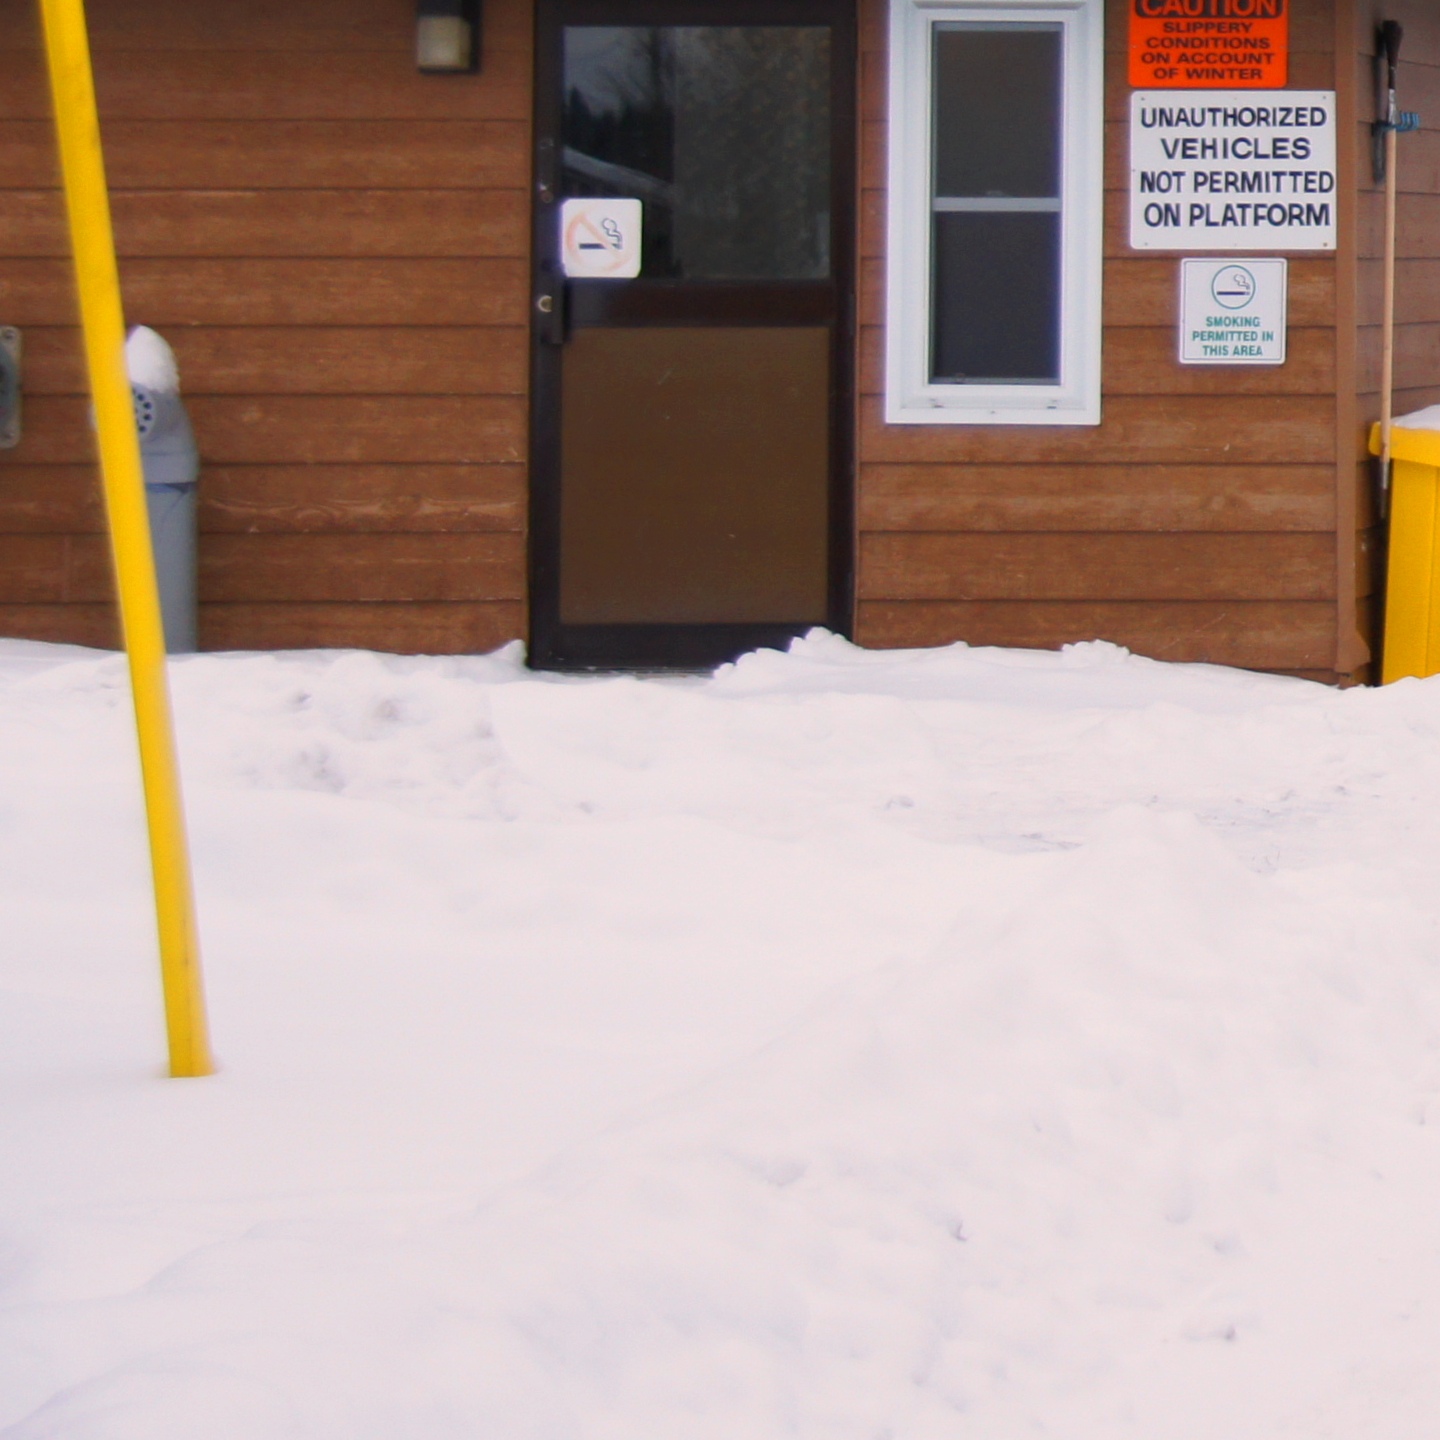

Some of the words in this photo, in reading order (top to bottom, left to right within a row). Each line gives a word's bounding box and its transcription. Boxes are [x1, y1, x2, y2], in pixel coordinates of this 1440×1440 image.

[1163, 22, 1253, 33] SLIPPERY
[1146, 37, 1270, 49] CONDITIONS
[1141, 53, 1170, 65] ON
[1177, 53, 1274, 64] ACCOUNT
[1153, 68, 1178, 79] OF
[1186, 68, 1263, 79] WINTER
[1140, 107, 1327, 128] UNAUTHORIZED
[1161, 137, 1311, 159] VEHICLES
[1140, 171, 1186, 193] NOT
[1193, 170, 1334, 193] PERMITTED
[1144, 202, 1181, 227] ON
[1189, 203, 1330, 227] PLATFORM
[1206, 316, 1260, 327] SMOKING
[1192, 331, 1258, 341] PERMITTED
[1262, 331, 1274, 341] IN
[1203, 345, 1229, 356] THIS
[1232, 345, 1263, 356] AREA
